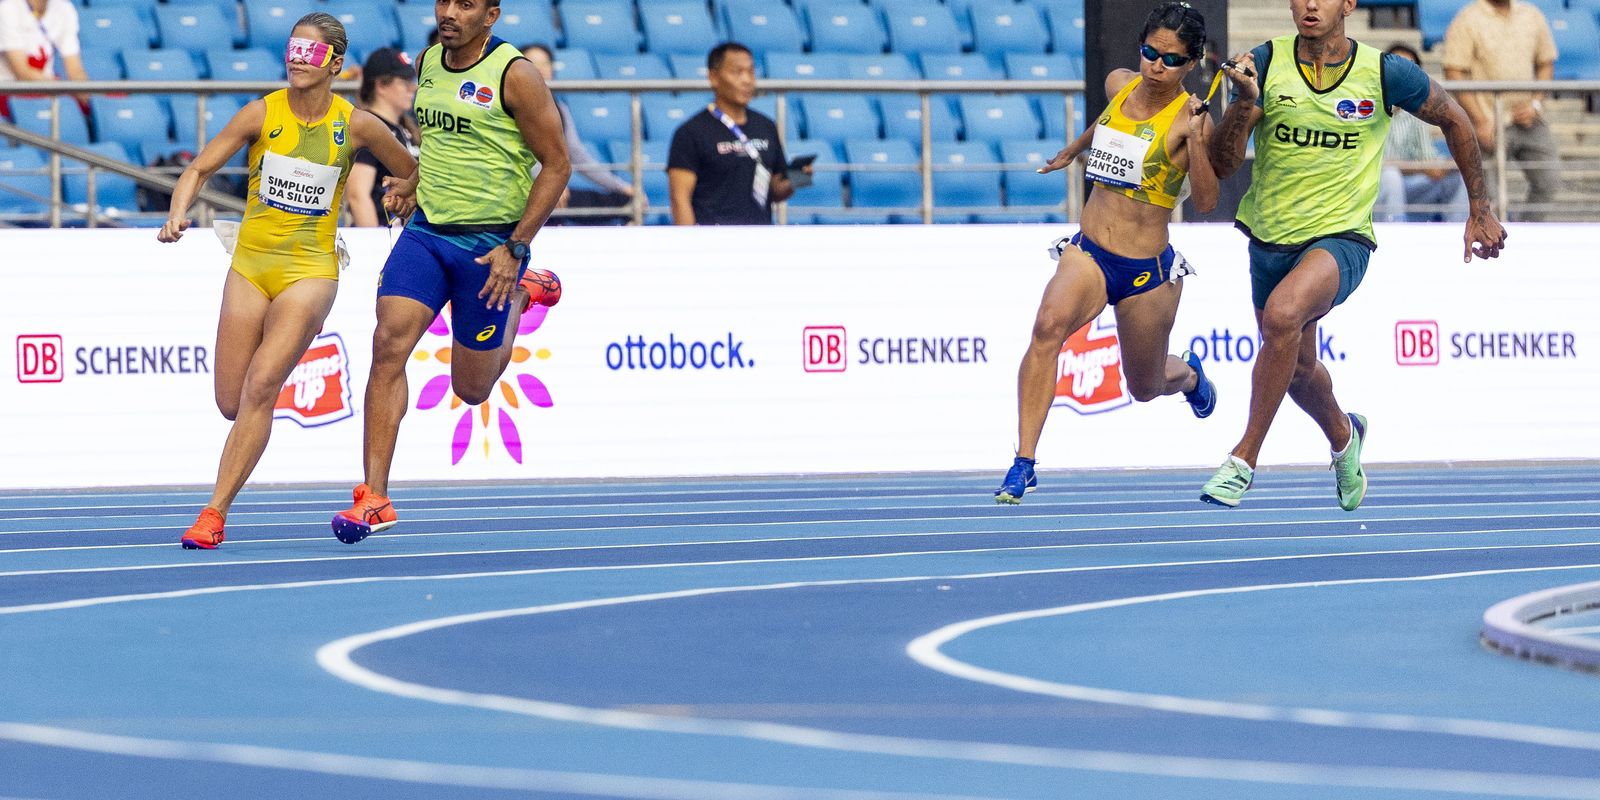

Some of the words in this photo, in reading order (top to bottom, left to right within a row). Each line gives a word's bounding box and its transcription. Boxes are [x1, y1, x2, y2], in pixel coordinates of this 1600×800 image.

[416, 107, 471, 134] GUIDE
[1275, 123, 1359, 149] GUIDE
[1087, 158, 1126, 177] SANTOS
[1113, 156, 1134, 169] DOS
[268, 175, 325, 195] SIMPLICIO
[269, 187, 284, 199] DA
[287, 191, 320, 205] SILVA
[606, 332, 754, 370] ottobock.
[809, 335, 841, 364] DB
[858, 337, 988, 364] SCHENKER
[1190, 326, 1346, 362] ottok.
[1401, 329, 1434, 358] DB
[1451, 332, 1577, 358] SCHENKER
[23, 343, 57, 375] DB
[75, 346, 209, 375] SCHENKER
